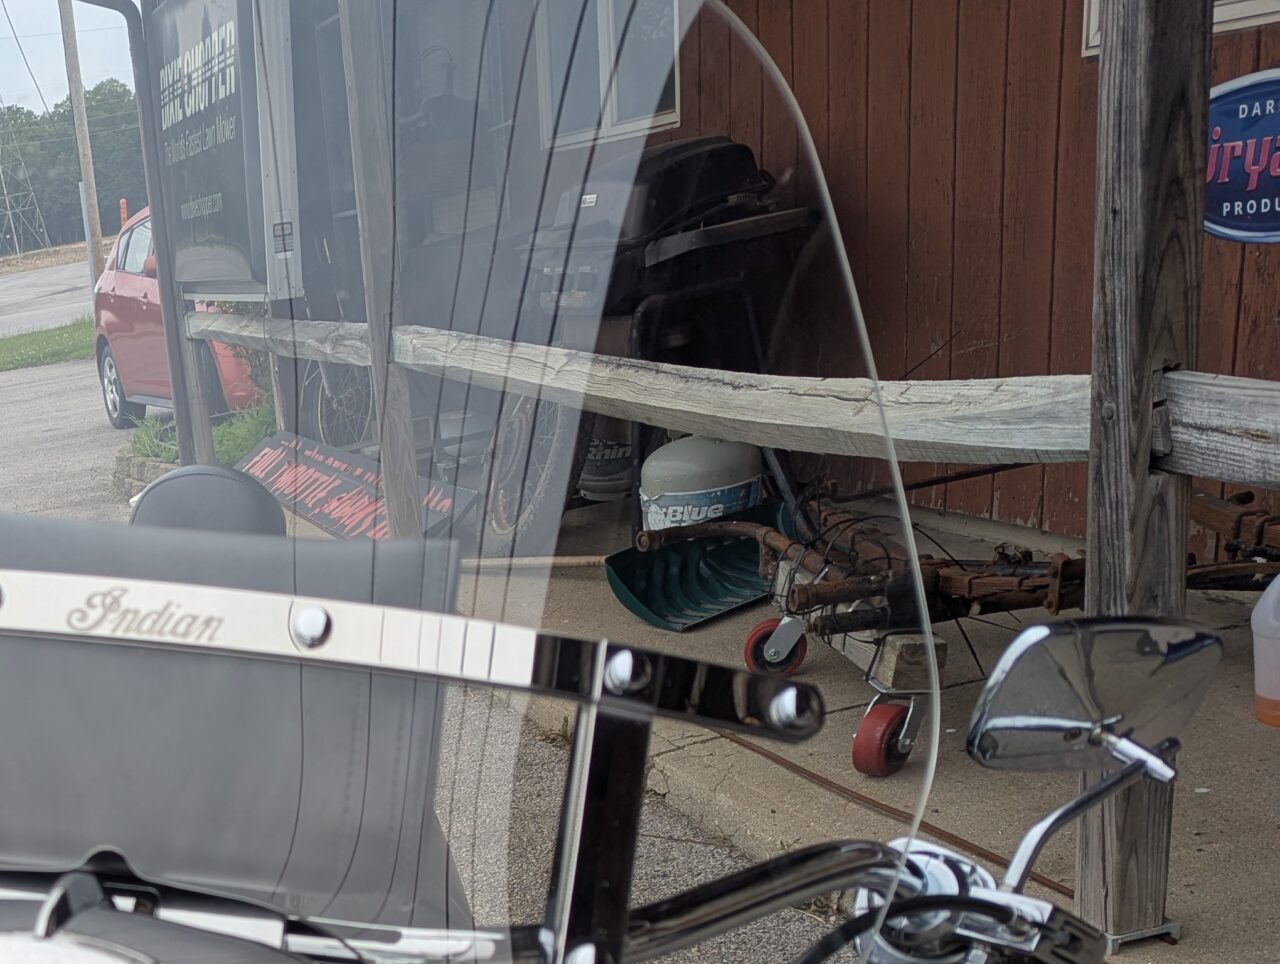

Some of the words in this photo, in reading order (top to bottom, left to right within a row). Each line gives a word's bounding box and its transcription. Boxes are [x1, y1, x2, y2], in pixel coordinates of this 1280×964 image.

[183, 20, 236, 118] CHOPPER
[202, 123, 216, 151] Lawn
[216, 113, 237, 144] Mower
[668, 503, 724, 521] Blue
[66, 586, 225, 643] Indian
